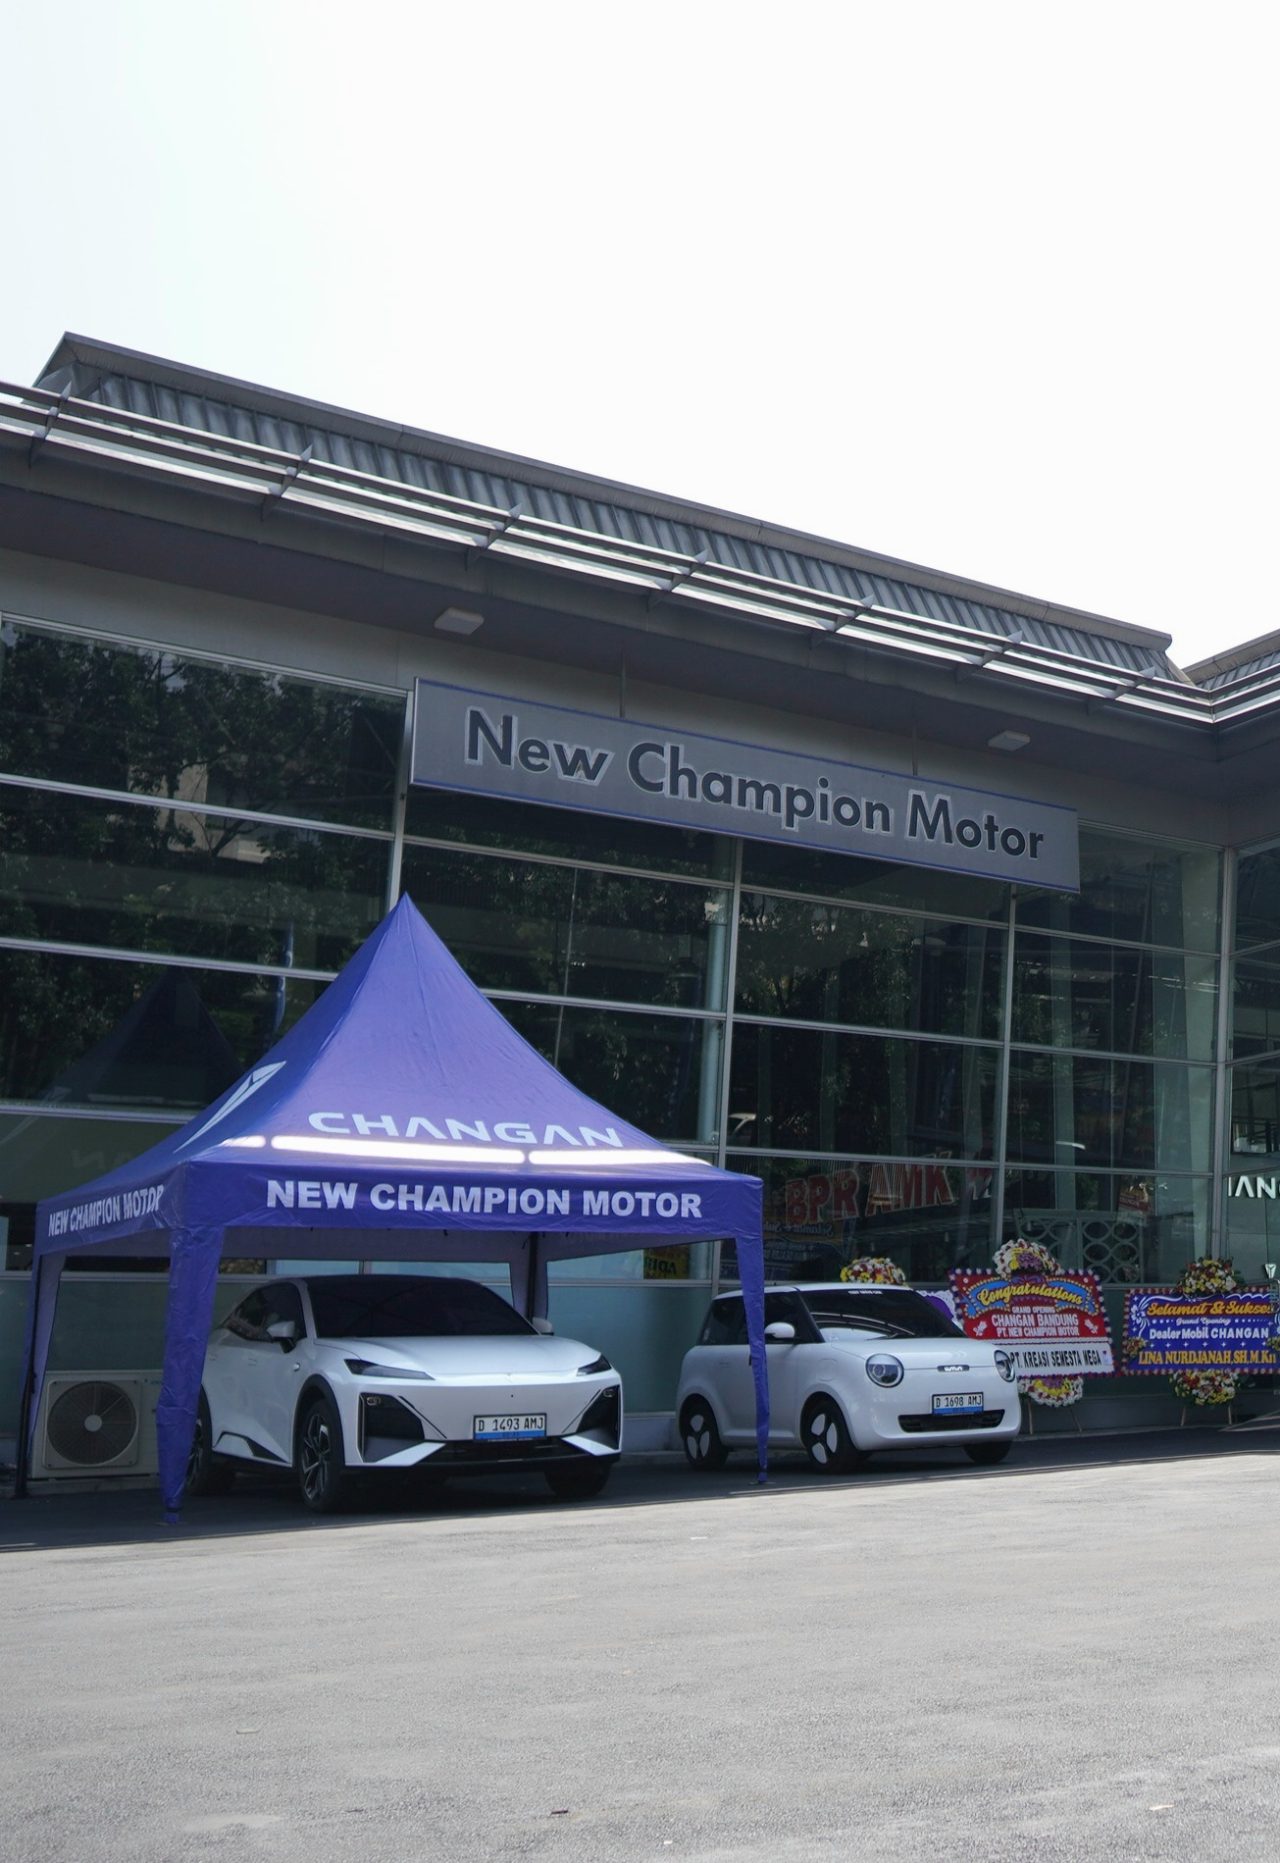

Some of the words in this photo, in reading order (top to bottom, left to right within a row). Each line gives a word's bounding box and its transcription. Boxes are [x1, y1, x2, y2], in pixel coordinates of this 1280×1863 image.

[466, 708, 611, 783] New
[628, 742, 892, 830] Champion
[909, 792, 1045, 861] Motor
[308, 1111, 624, 1148] CHANGAN
[266, 1180, 358, 1210] NEW
[370, 1183, 571, 1215] CHAMPION
[582, 1191, 703, 1218] MOTOR
[49, 1209, 70, 1238] NEW
[70, 1195, 121, 1232] CHAMPION
[977, 1282, 1083, 1306] Congratulations
[1147, 1302, 1208, 1316] Selamat
[991, 1314, 1035, 1327] CHANGAN
[1038, 1314, 1079, 1327] BANDUNG
[1150, 1327, 1181, 1340] Dealer
[1181, 1327, 1209, 1340] Mobil
[1211, 1327, 1269, 1339] CHANGAN
[1023, 1351, 1050, 1369] KREASI
[1051, 1350, 1082, 1368] SEMESTA
[1084, 1349, 1102, 1367] MEGA
[1138, 1351, 1163, 1365] LINA
[478, 1419, 485, 1432] D
[492, 1418, 520, 1431] 1493
[524, 1417, 544, 1429] AMJ
